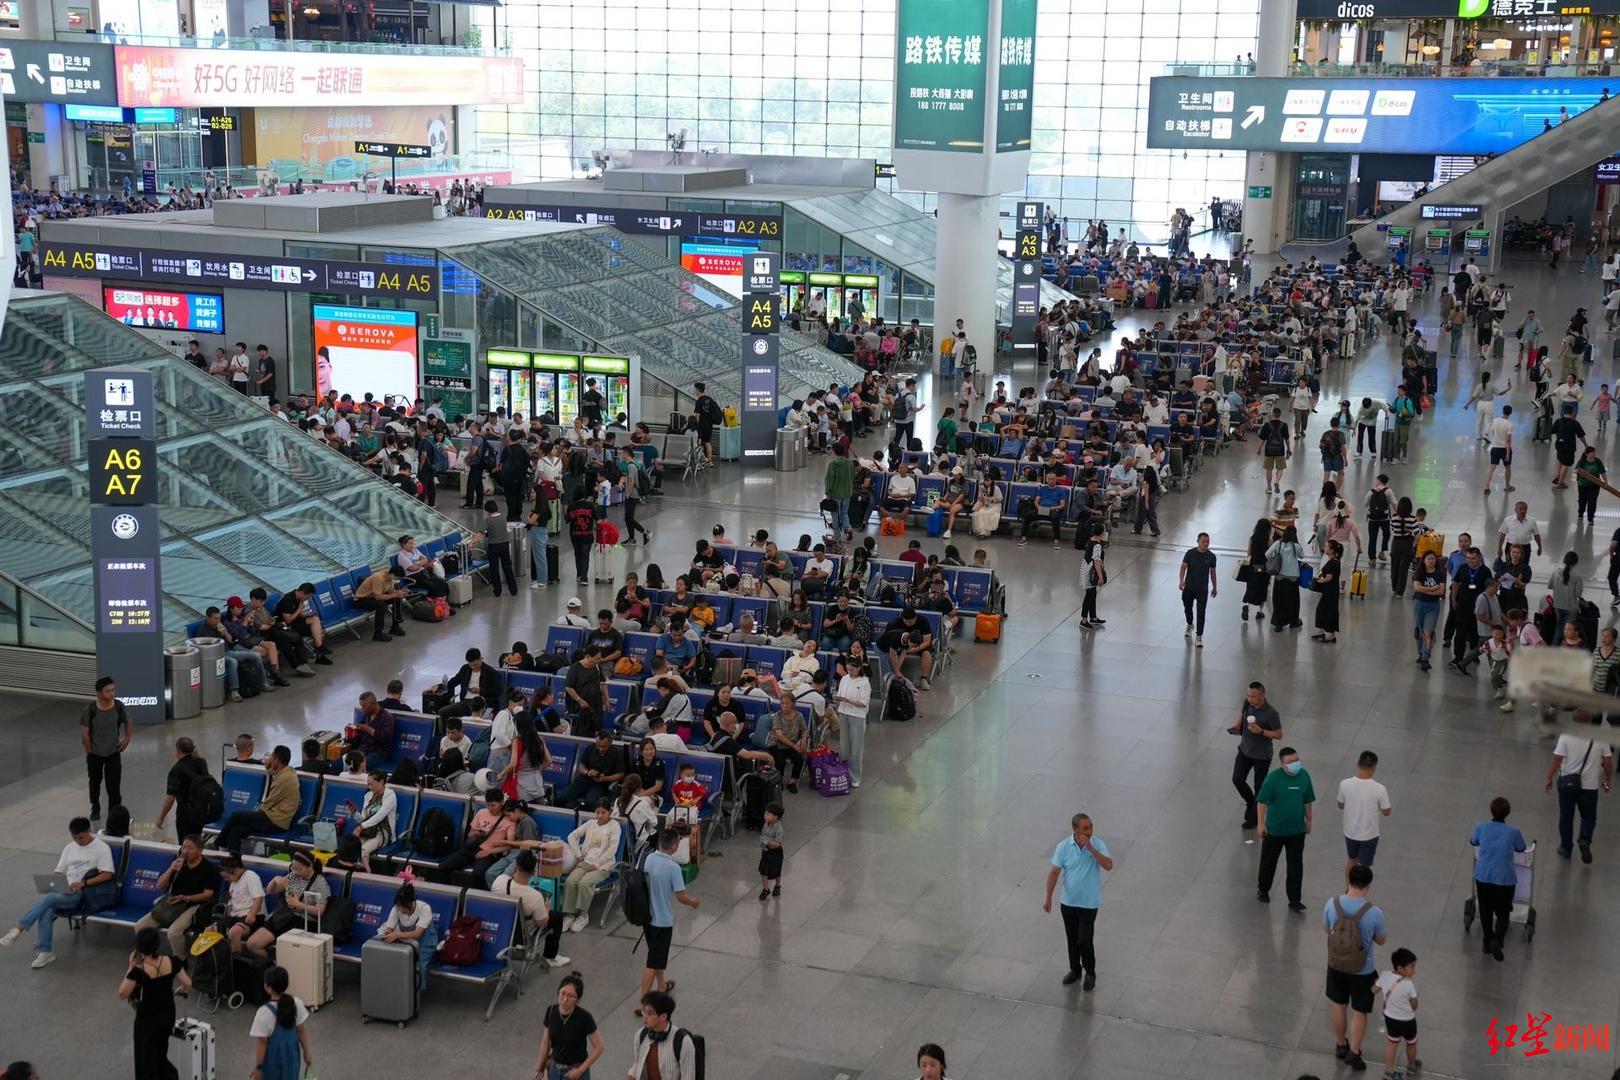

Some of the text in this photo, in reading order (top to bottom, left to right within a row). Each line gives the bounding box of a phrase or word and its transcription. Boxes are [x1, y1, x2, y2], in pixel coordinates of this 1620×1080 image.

[1337, 1, 1375, 18] dicos
[1491, 0, 1555, 16] 德克士
[905, 35, 982, 65] 路铁传媒
[65, 55, 91, 67] 卫生间
[66, 78, 101, 90] 自动扶梯
[194, 64, 238, 95] 好5G
[245, 65, 294, 95] 好网络
[301, 66, 363, 95] 一起联通
[1178, 92, 1213, 104] 卫生间
[917, 101, 929, 109] 188
[931, 101, 946, 110] 1777
[1165, 119, 1211, 131] 自动扶梯
[358, 143, 369, 152] A1
[397, 145, 408, 154] A1
[486, 208, 502, 220] A2
[507, 209, 524, 221] A3
[737, 220, 778, 235] A2 A3
[1022, 235, 1037, 245] A2
[1021, 246, 1037, 256] A3
[44, 249, 95, 270] A4 A5
[111, 255, 133, 264] 检票口
[205, 262, 228, 272] 饮用水
[248, 265, 271, 275] 卫生间
[336, 270, 359, 280] 检票口
[750, 276, 774, 284] 检票口
[377, 271, 431, 293] A4 A5
[144, 294, 180, 307] 选择超多
[195, 297, 217, 307] 找工作
[751, 300, 772, 313] A4
[751, 315, 772, 328] A5
[350, 326, 395, 338] SEROVA
[100, 409, 141, 422] 检票口
[100, 422, 141, 430] Ticket Check
[104, 448, 142, 471] A6
[105, 474, 142, 496] A7
